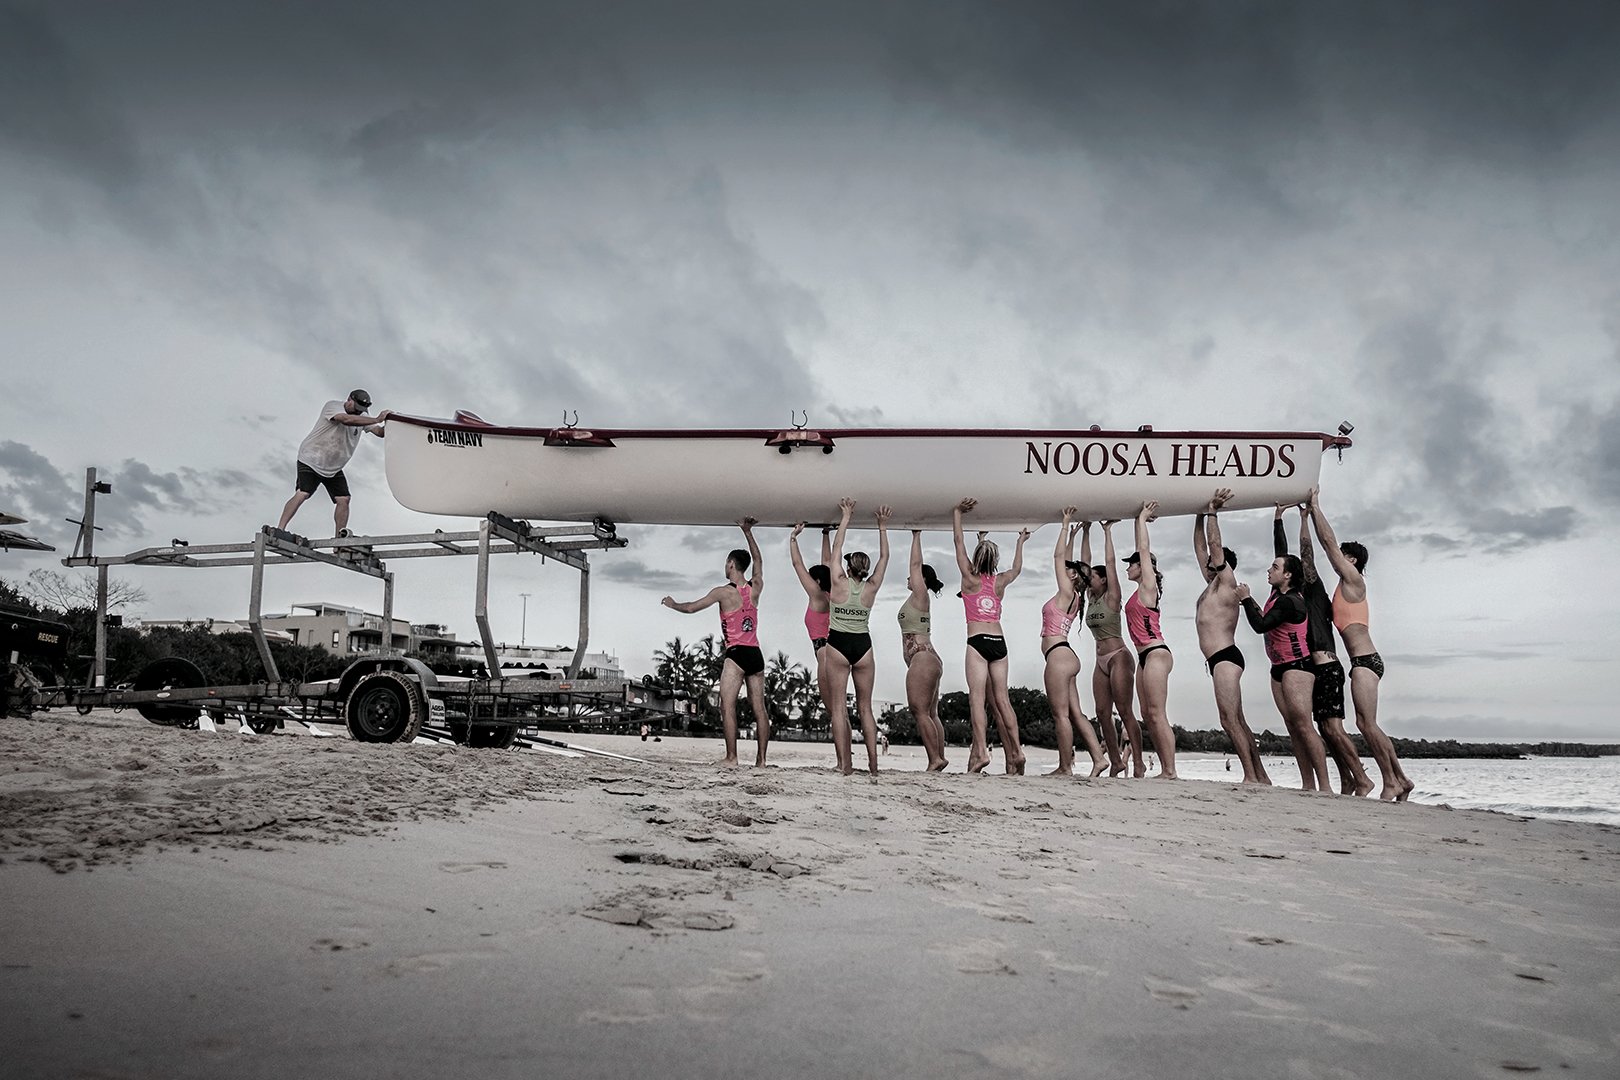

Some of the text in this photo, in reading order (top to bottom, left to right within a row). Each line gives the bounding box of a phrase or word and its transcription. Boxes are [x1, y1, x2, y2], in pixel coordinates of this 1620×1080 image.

[433, 429, 483, 447] TEAM NAVY
[1024, 442, 1296, 478] NOOSA HEADS
[38, 632, 59, 644] RESCUE
